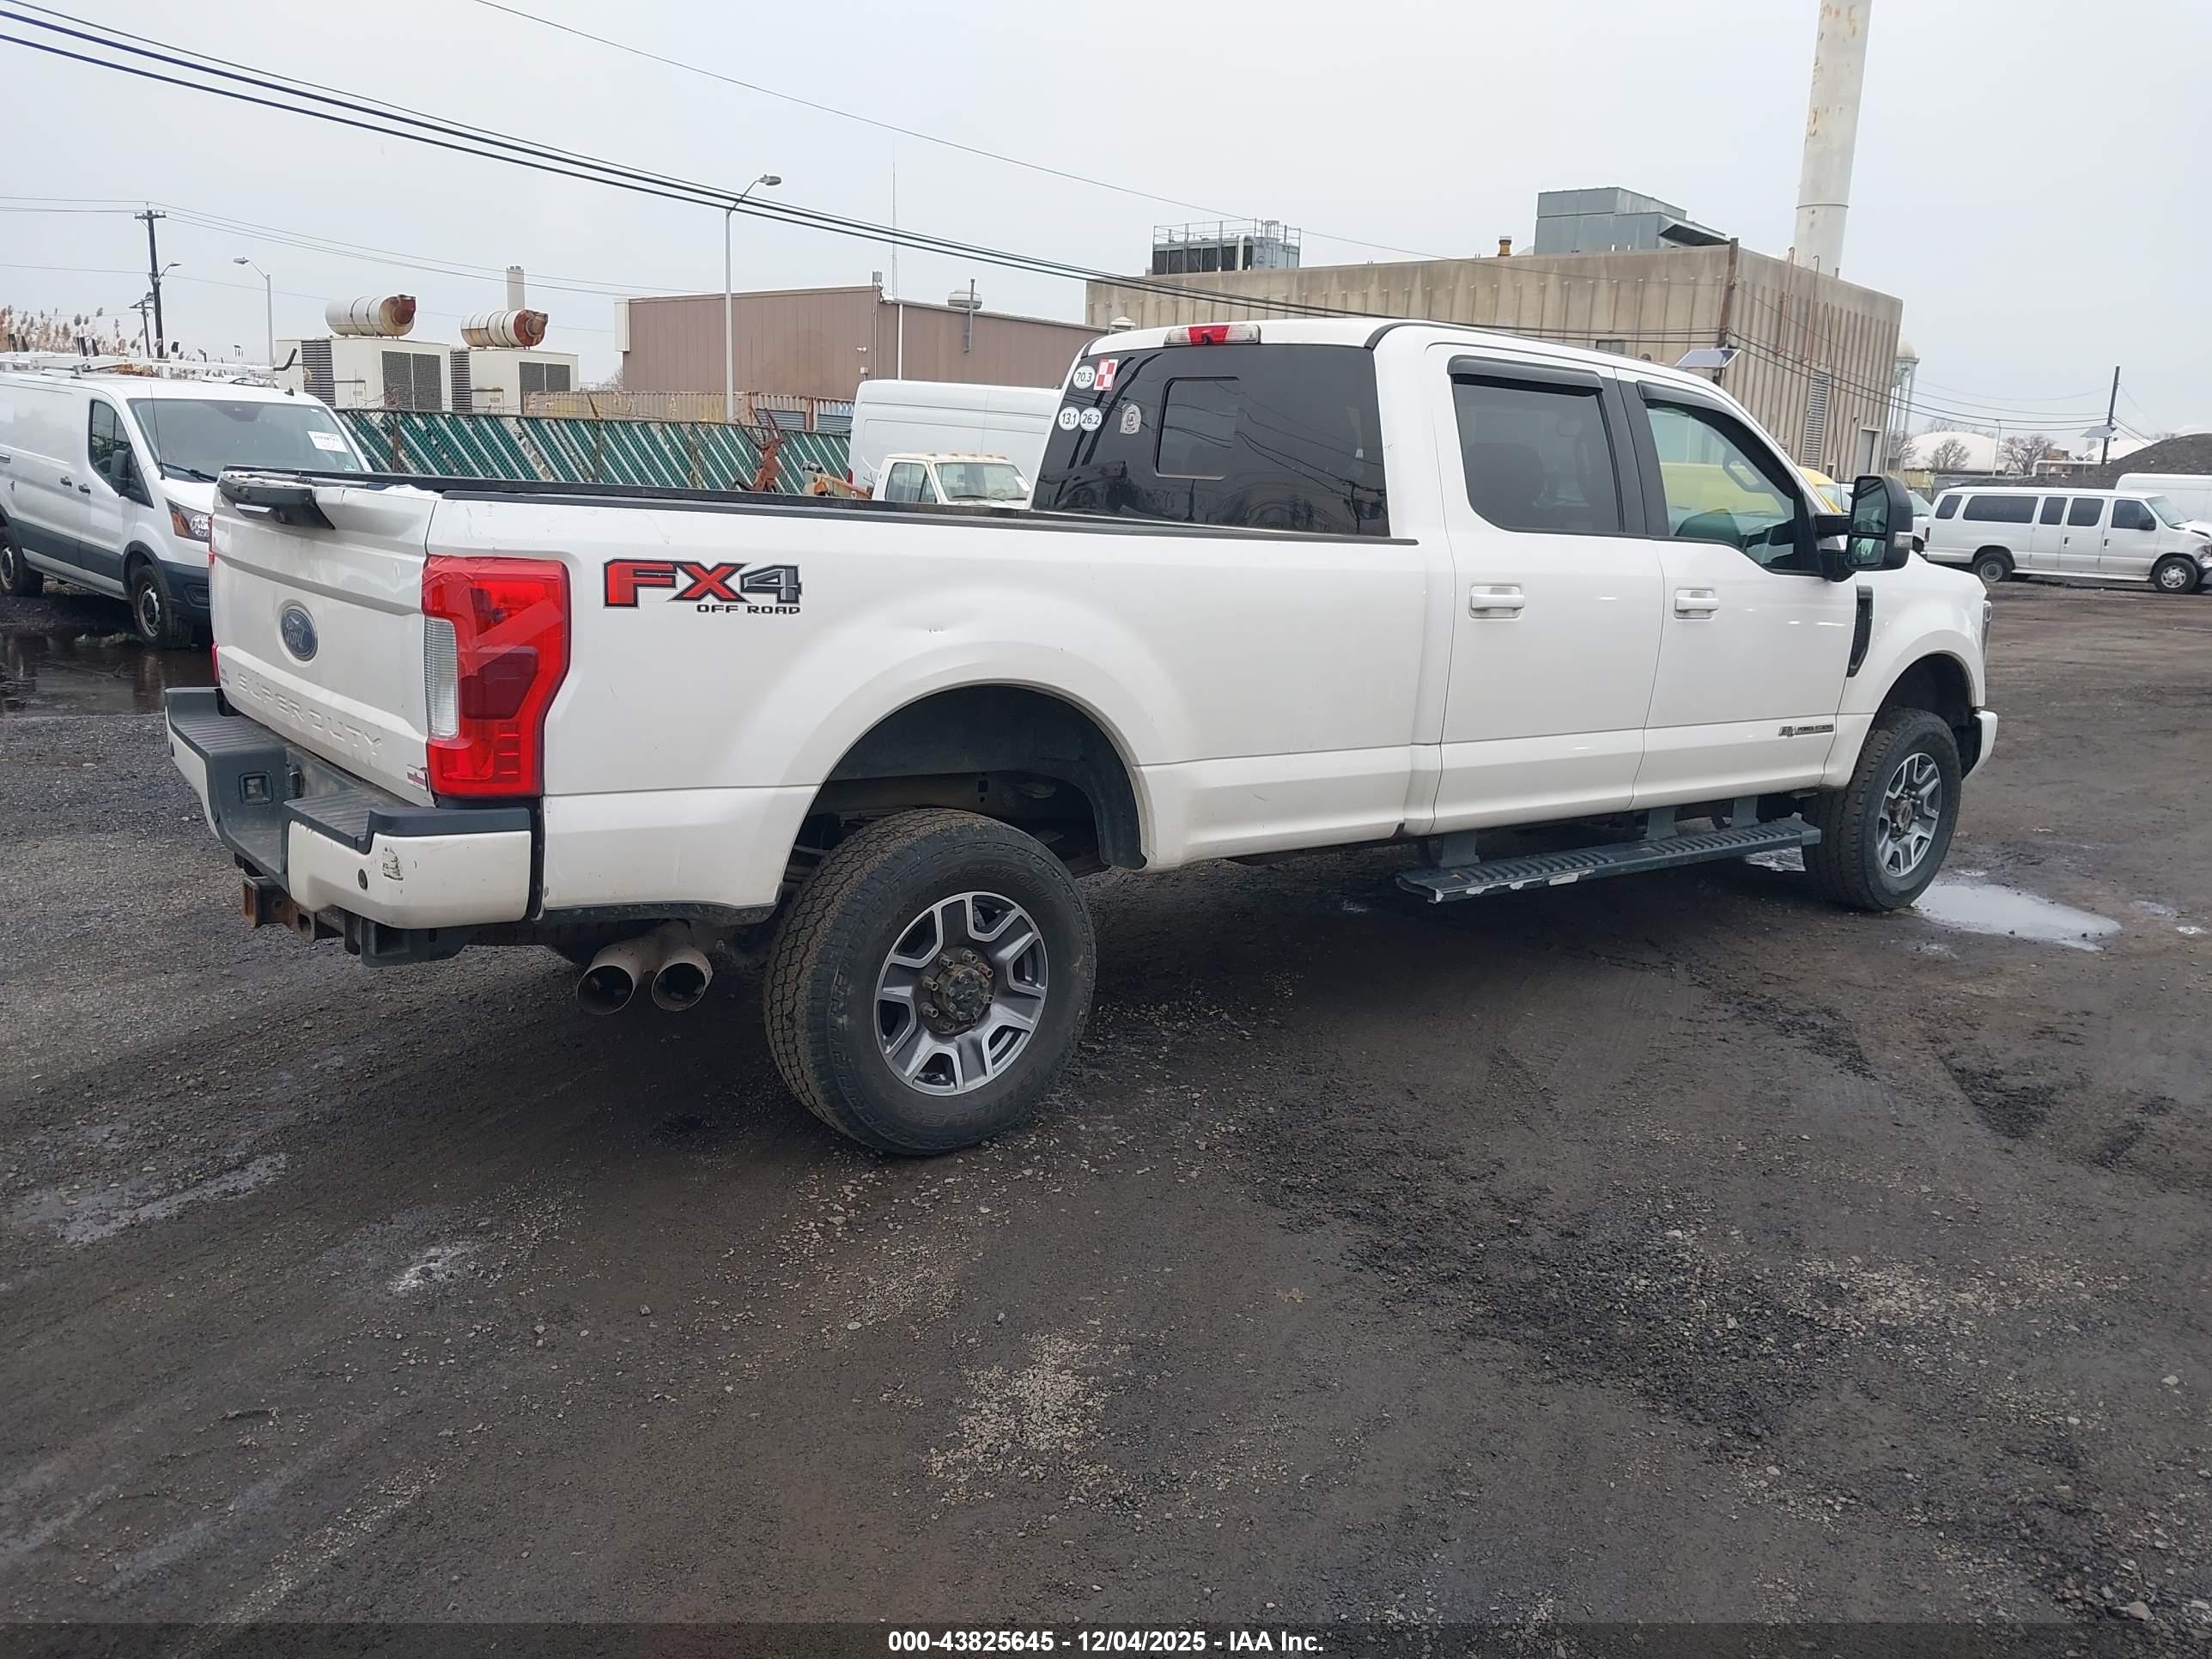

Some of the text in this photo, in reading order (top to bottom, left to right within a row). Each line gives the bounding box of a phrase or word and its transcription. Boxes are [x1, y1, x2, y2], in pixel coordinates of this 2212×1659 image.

[1075, 372, 1093, 383] 70.3
[1061, 412, 1077, 425] 13.1
[1081, 413, 1100, 425] 26.2
[604, 558, 802, 607] FX4
[696, 604, 801, 615] OFF ROAD
[284, 615, 311, 650] Ford
[238, 672, 382, 757] SUPER DUTY
